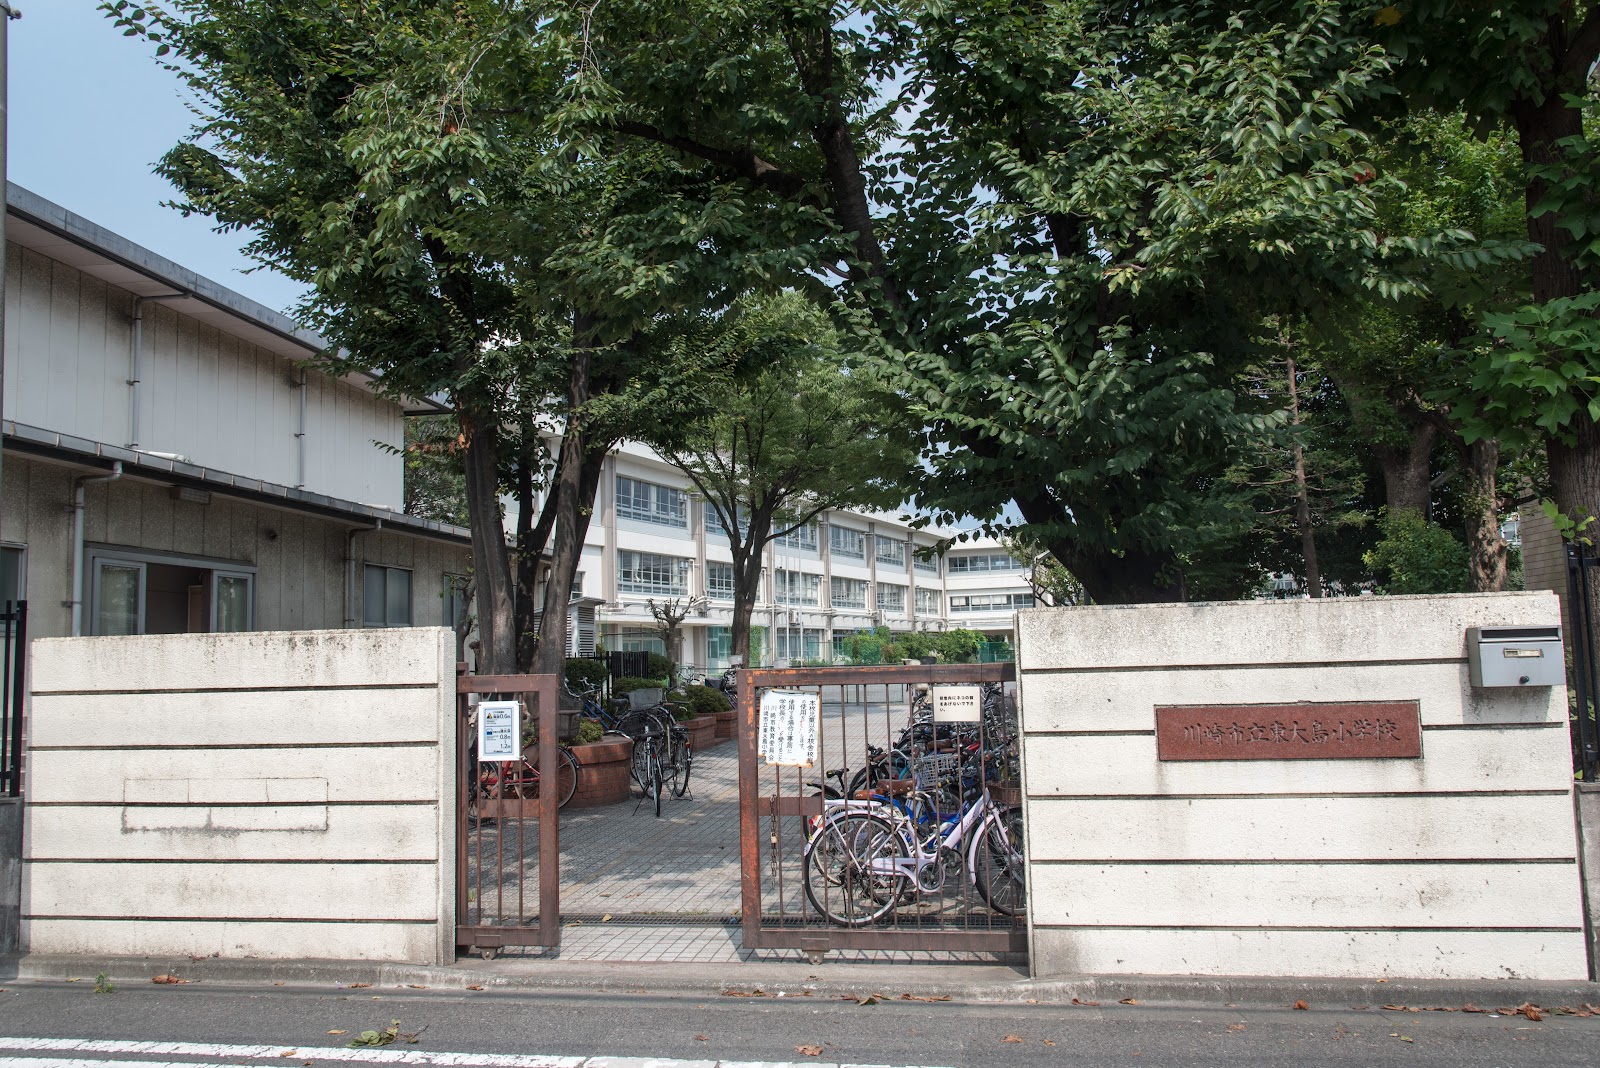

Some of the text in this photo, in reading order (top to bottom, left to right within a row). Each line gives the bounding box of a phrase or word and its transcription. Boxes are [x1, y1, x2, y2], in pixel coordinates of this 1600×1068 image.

[1183, 718, 1400, 746] 川崎市立東大島小学校
